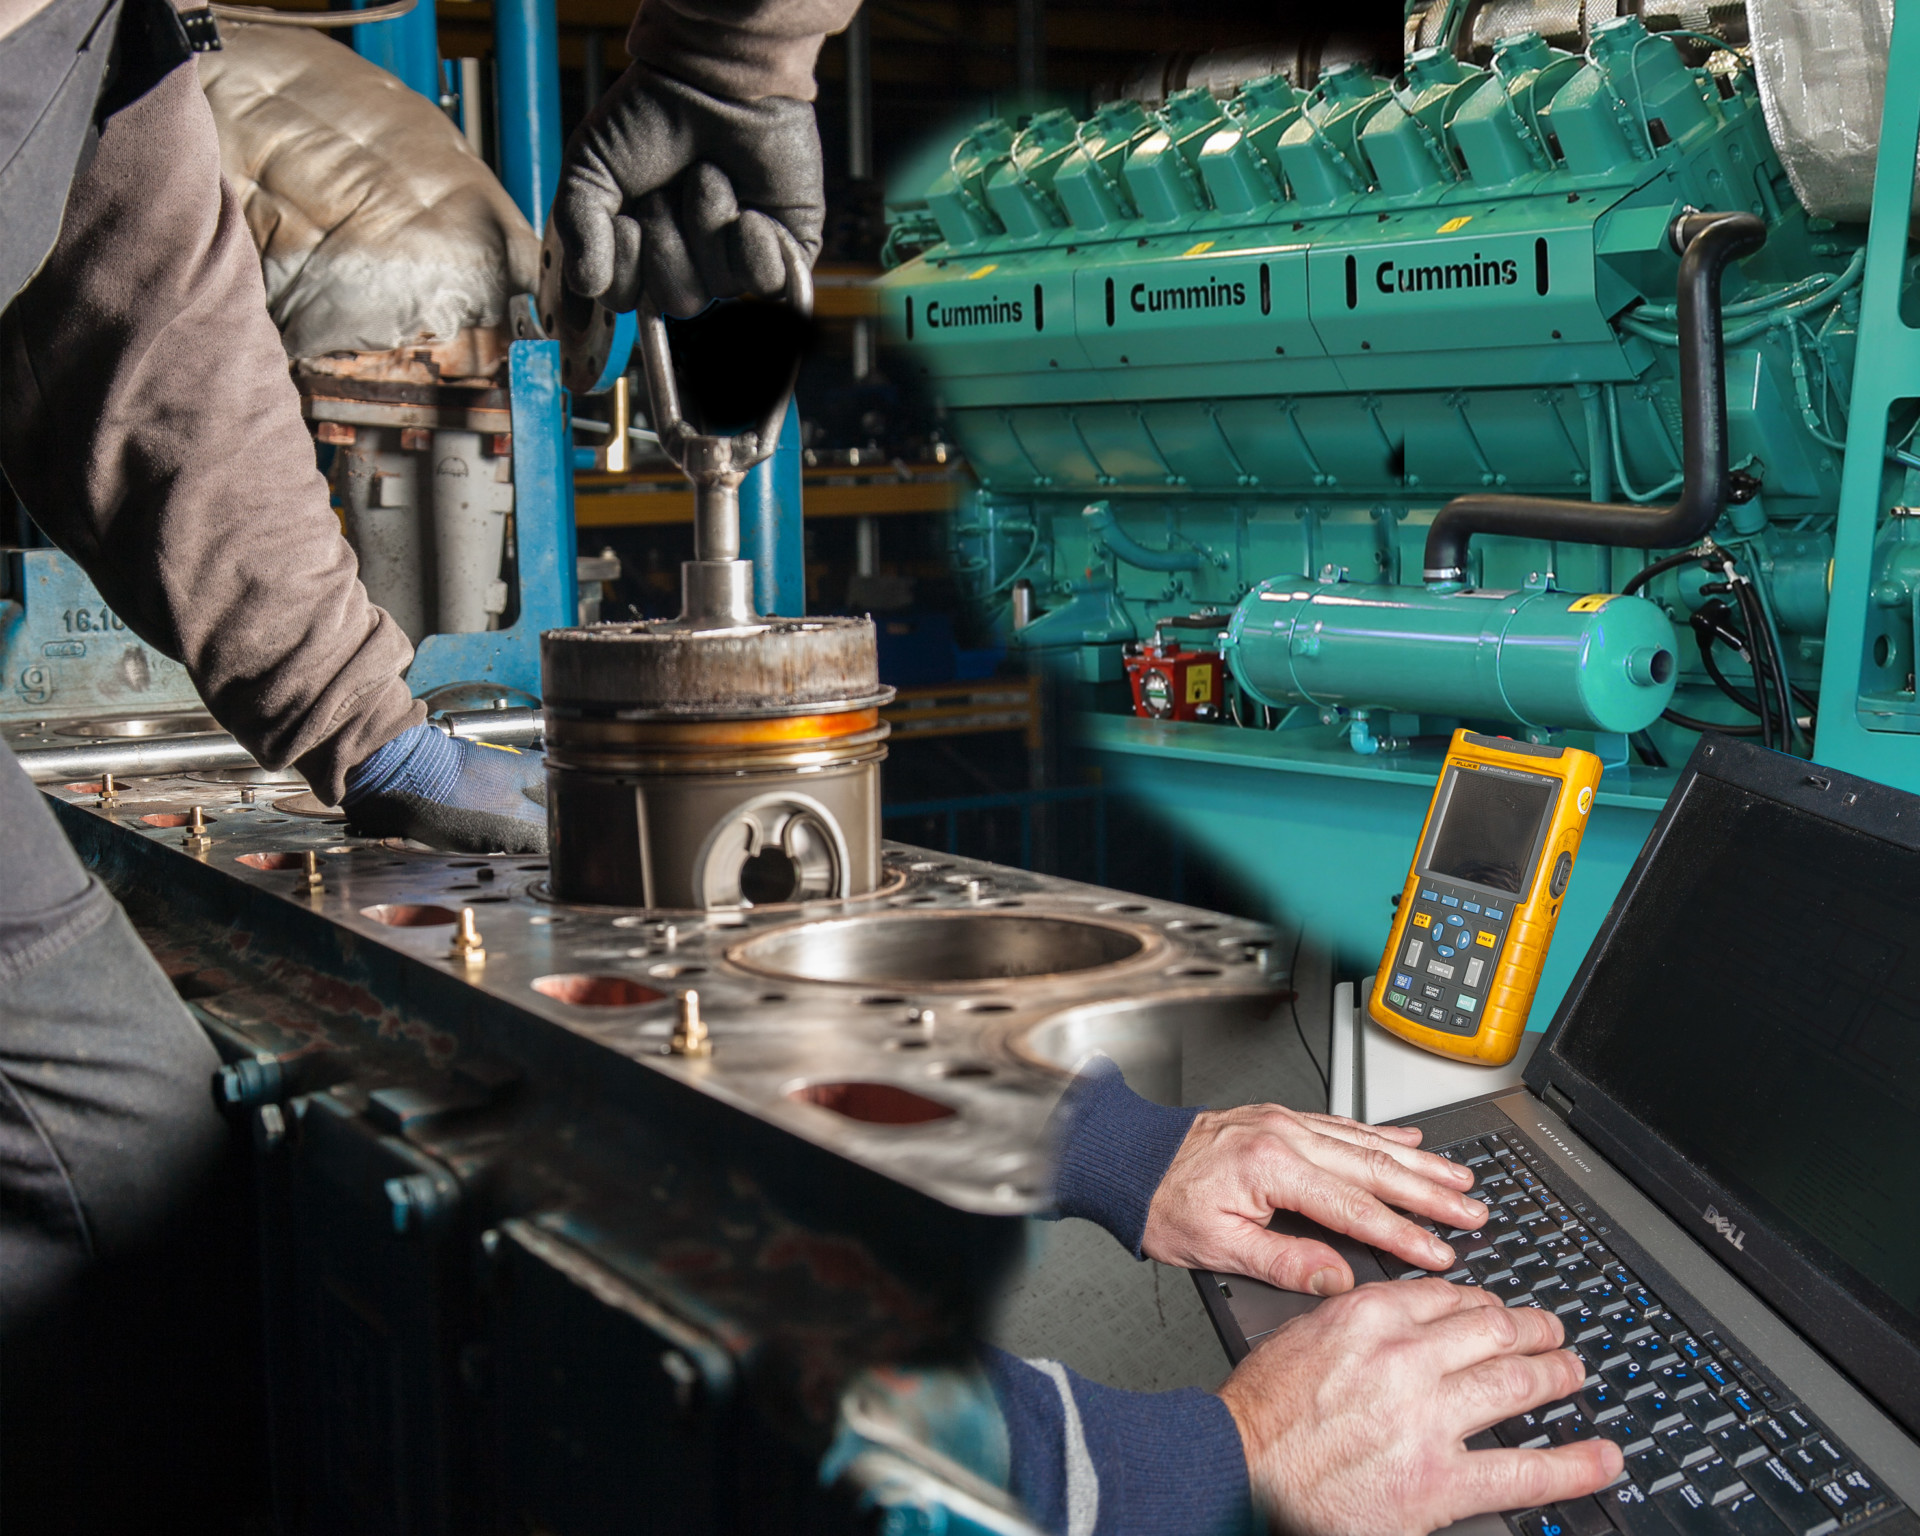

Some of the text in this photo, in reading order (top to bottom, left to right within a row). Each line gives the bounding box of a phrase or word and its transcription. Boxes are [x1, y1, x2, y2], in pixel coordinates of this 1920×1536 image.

[1376, 252, 1518, 294] Cummins
[1130, 276, 1246, 313] Cummins
[926, 296, 1023, 328] Cummins
[1456, 761, 1478, 769] FLUKE
[1426, 985, 1440, 994] SCOPE
[1432, 1007, 1443, 1015] SAVE
[1537, 1123, 1573, 1155] LATITUDE
[1702, 1203, 1746, 1252] DELL
[1471, 1231, 1482, 1239] D
[1517, 1237, 1528, 1245] R
[1465, 1276, 1476, 1284] V
[1509, 1277, 1520, 1285] G
[1559, 1282, 1570, 1290] Y
[1529, 1300, 1542, 1309] H
[1580, 1307, 1592, 1316] U
[1662, 1312, 1672, 1320] F9
[1685, 1336, 1698, 1347] F10
[1710, 1361, 1723, 1372] F11
[1597, 1383, 1608, 1393] L
[1736, 1388, 1750, 1400] F12
[1653, 1391, 1666, 1400] P
[1789, 1409, 1808, 1428] Insert
[1768, 1419, 1788, 1439] Delete
[1819, 1439, 1840, 1459] Home
[1797, 1449, 1814, 1464] End
[1769, 1457, 1804, 1493] Backspace
[1845, 1474, 1858, 1487] Up
[1852, 1470, 1871, 1489] Page
[1628, 1483, 1645, 1503] Shift
[1684, 1484, 1704, 1504] Enter
[1822, 1484, 1844, 1506] Down
[1829, 1481, 1849, 1500] Page
